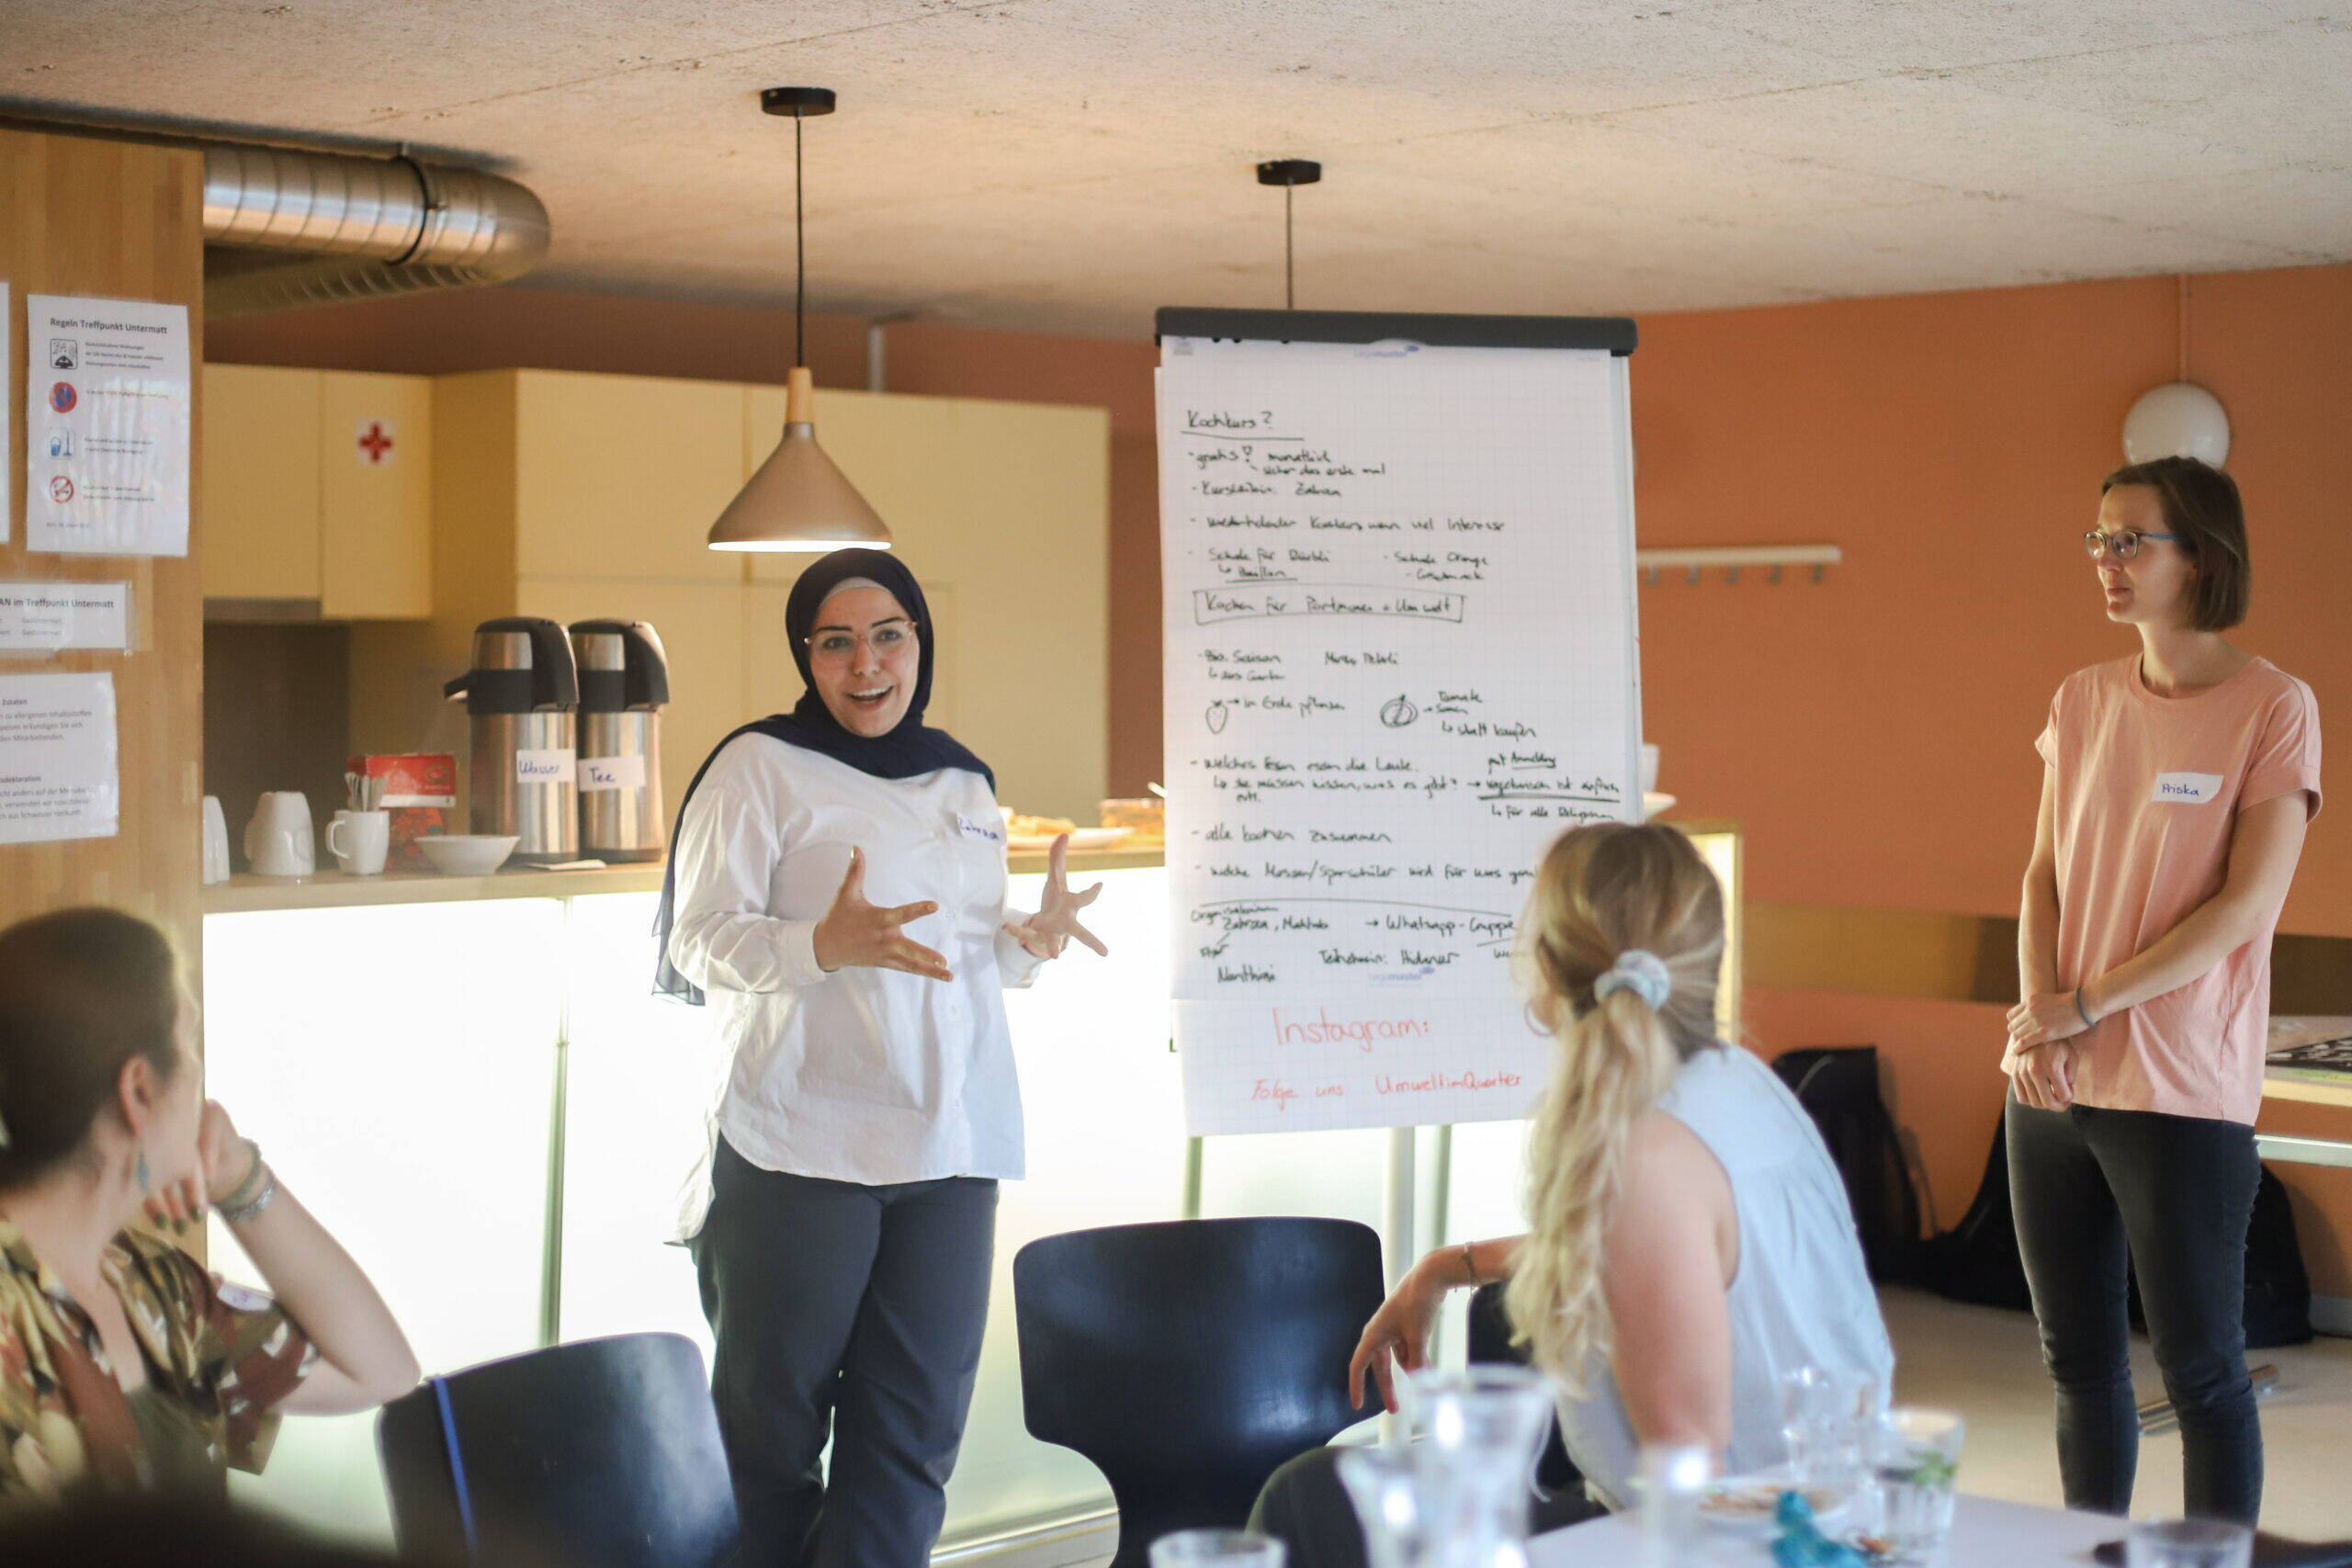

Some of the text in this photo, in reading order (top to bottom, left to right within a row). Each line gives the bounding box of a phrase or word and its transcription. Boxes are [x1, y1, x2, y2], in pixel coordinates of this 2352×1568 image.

[50, 317, 168, 335] Regeln Treffpunkt Untermatt
[13, 598, 24, 606] im
[26, 598, 70, 608] Treffpunkt
[72, 599, 114, 608] Untermatt
[518, 760, 560, 774] Wasser
[588, 766, 616, 784] Tee
[2162, 783, 2199, 796] Priska
[1272, 1006, 1430, 1053] Instagram:
[1250, 1077, 1301, 1111] Folge
[1314, 1084, 1344, 1098] uns
